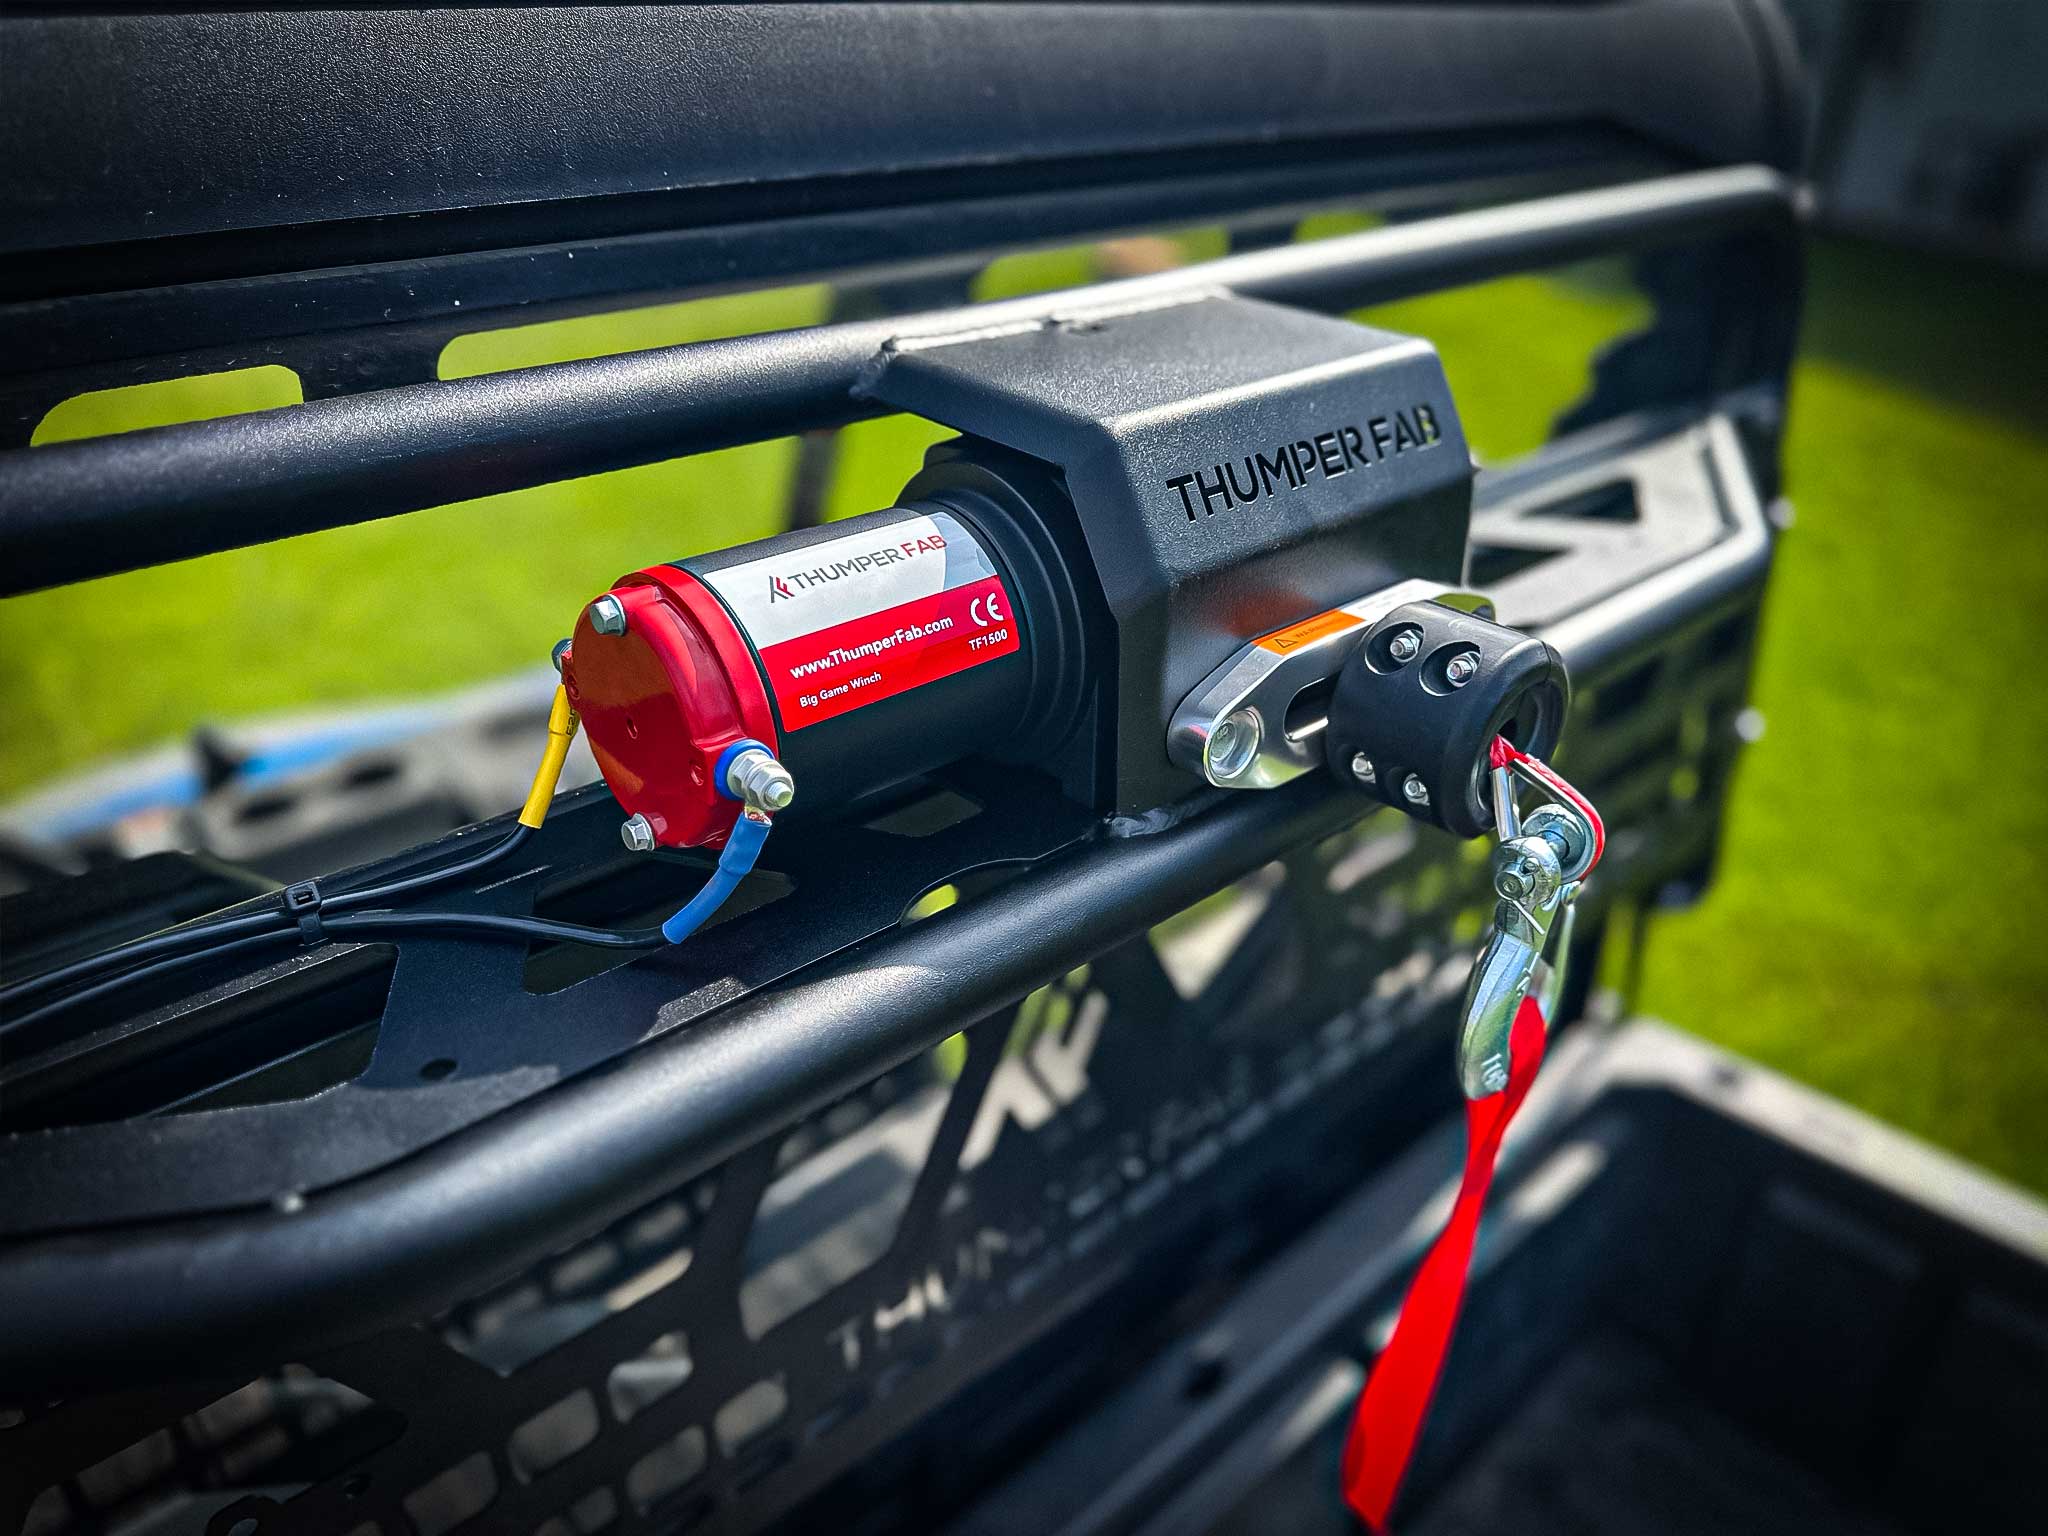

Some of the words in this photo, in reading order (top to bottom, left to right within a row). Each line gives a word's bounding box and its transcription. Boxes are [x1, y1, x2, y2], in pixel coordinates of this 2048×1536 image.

[1166, 427, 1371, 523] THUMPER
[1368, 402, 1441, 460] FAB
[787, 548, 905, 589] THUMPER
[900, 535, 948, 558] FAB
[970, 592, 1004, 627] CE
[789, 616, 954, 679] www.ThumperFab.com
[968, 628, 1008, 652] TF1500
[799, 694, 819, 708] Big
[819, 684, 849, 701] Game
[850, 672, 882, 690] Winch
